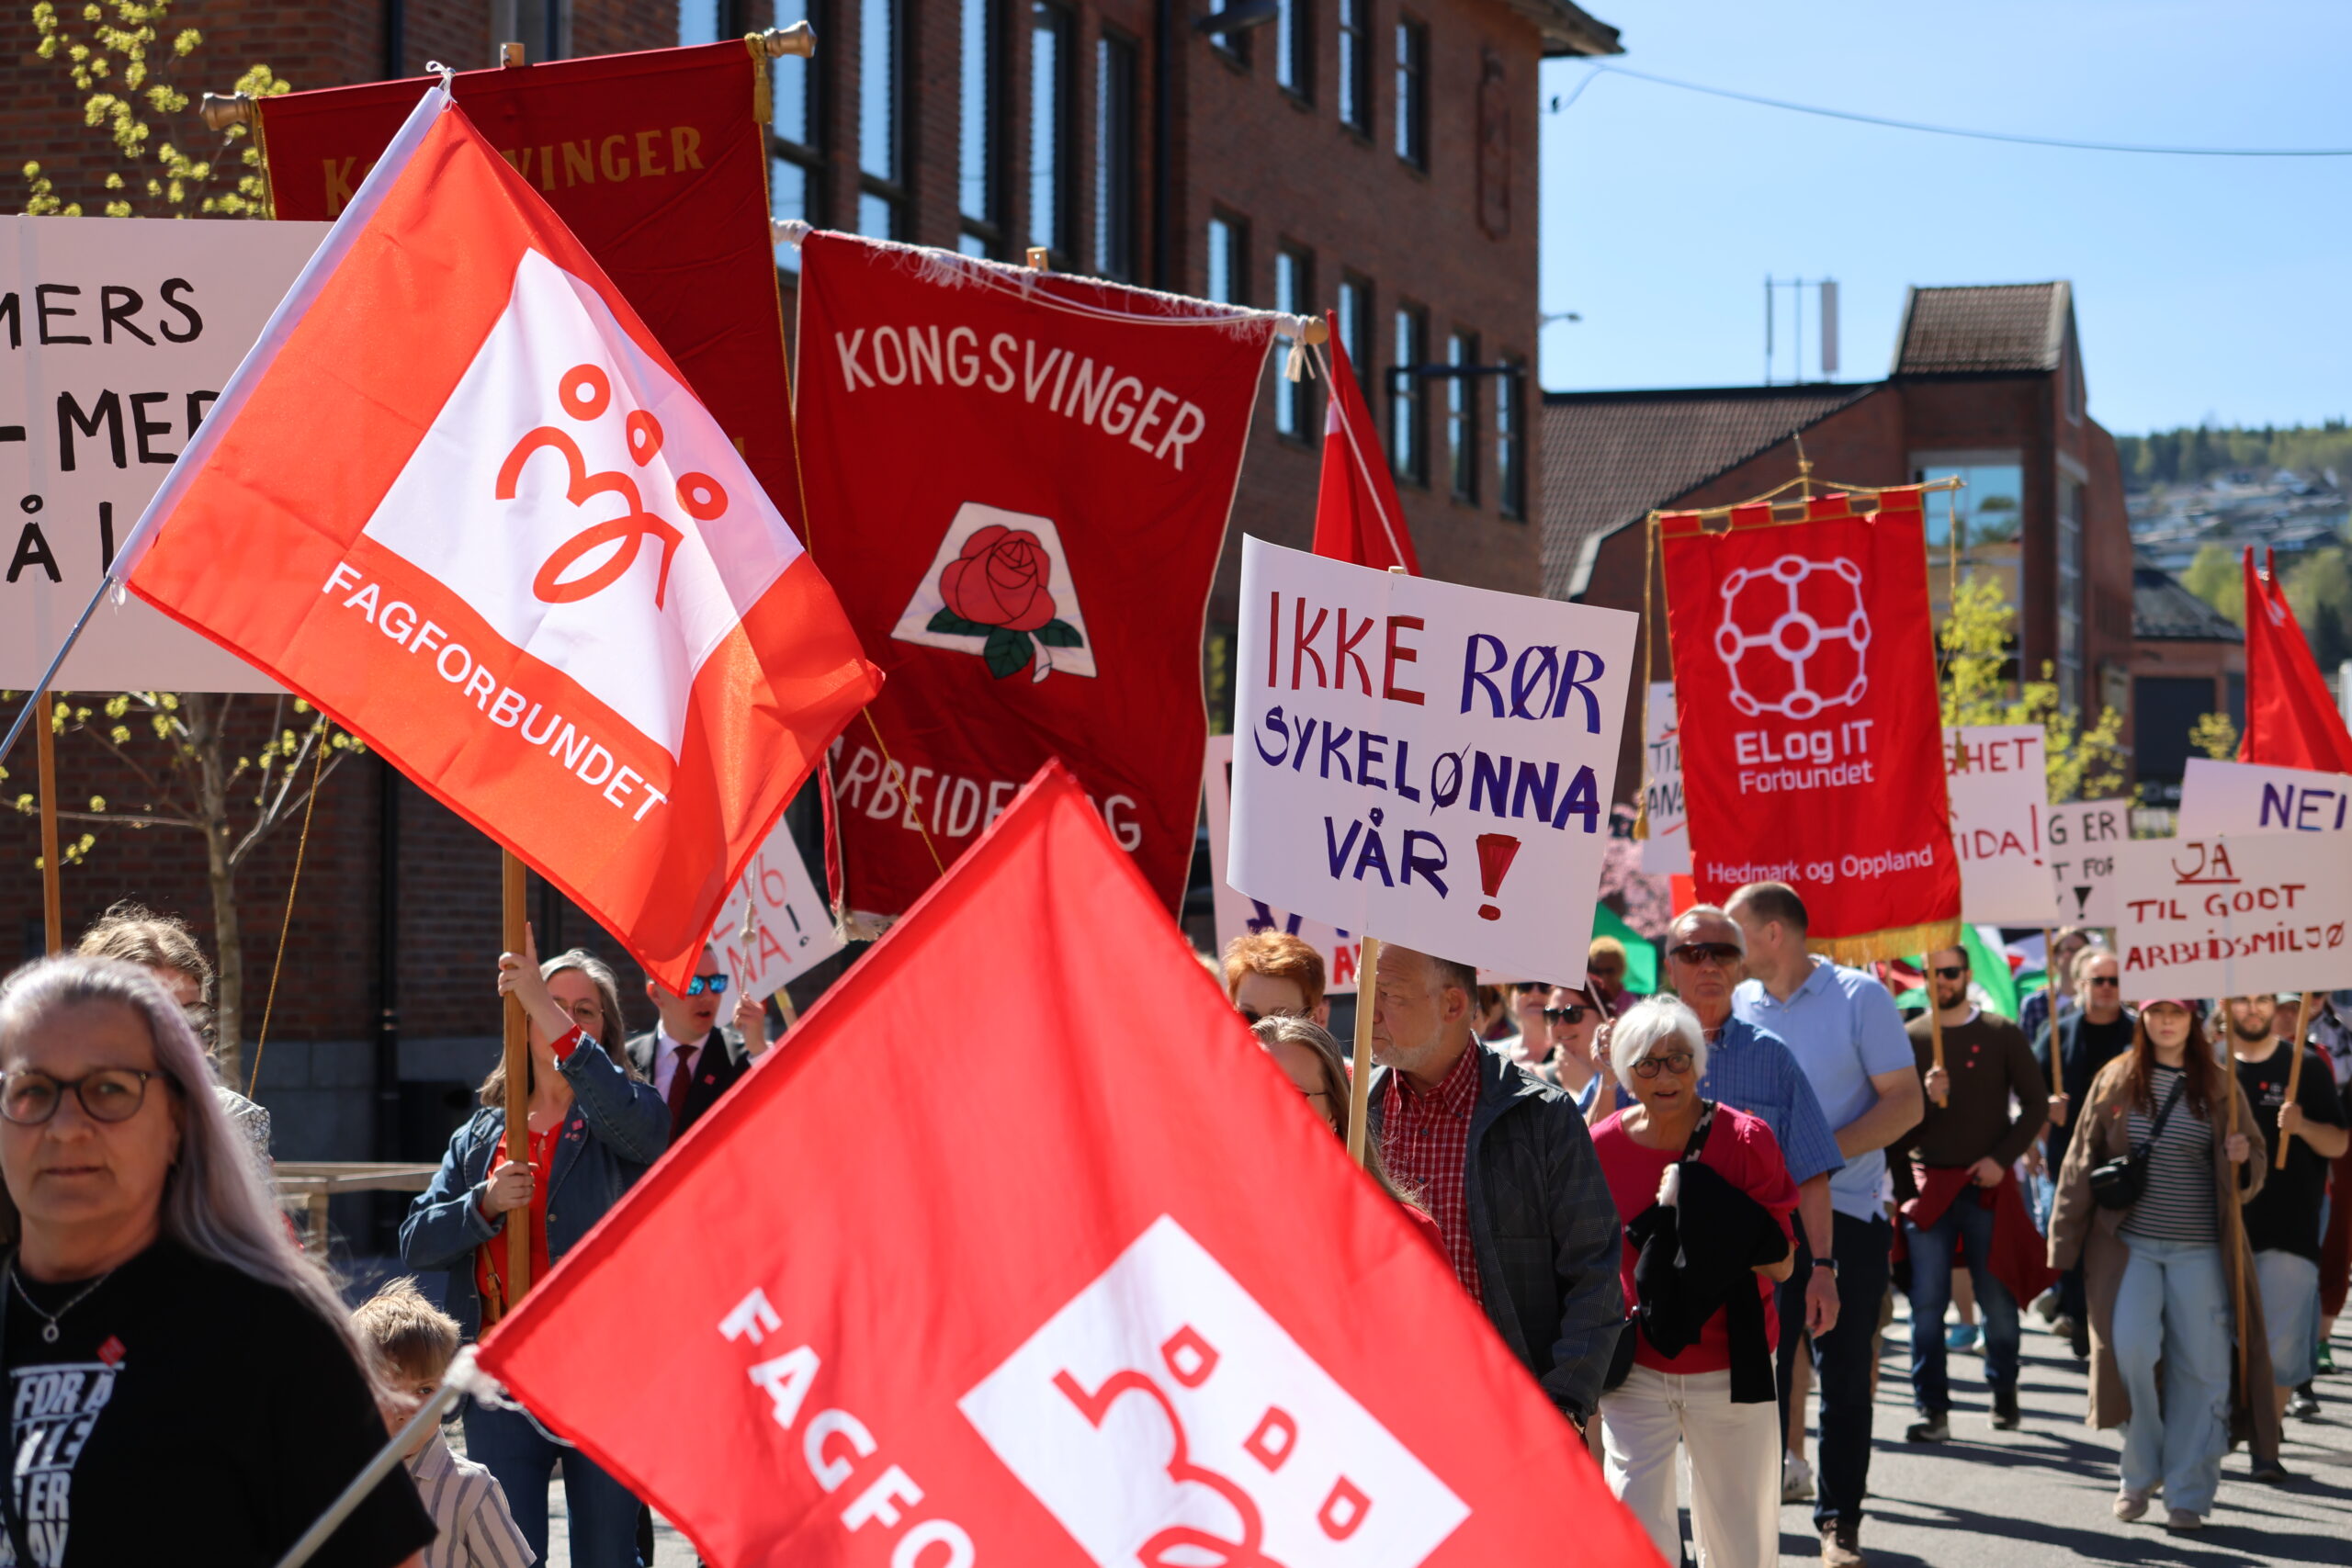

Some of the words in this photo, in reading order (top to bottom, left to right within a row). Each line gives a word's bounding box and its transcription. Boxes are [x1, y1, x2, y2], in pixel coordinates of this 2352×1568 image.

[322, 126, 705, 217] KVINGER
[835, 325, 1205, 471] KONGSVINGER
[1268, 592, 1425, 705] IKKE
[1461, 632, 1605, 734] RØR
[322, 561, 668, 822] FAGFORBUNDET
[1735, 730, 1834, 764] ELog
[1841, 719, 1873, 755] IT
[1253, 705, 1600, 834] SYKELØNNA
[1739, 760, 1874, 795] Forbundet
[2083, 811, 2118, 842] ER
[2259, 782, 2346, 831] NEI
[1325, 807, 1449, 900] VÅR
[1957, 805, 2043, 867] IDA!
[1706, 861, 1801, 884] Hedmark
[1805, 861, 1834, 884] og
[1840, 843, 1933, 880] Oppland
[2172, 843, 2233, 879] JA
[2127, 899, 2187, 923] TIL
[2204, 885, 2306, 918] GODT
[13, 1372, 85, 1421] FOR
